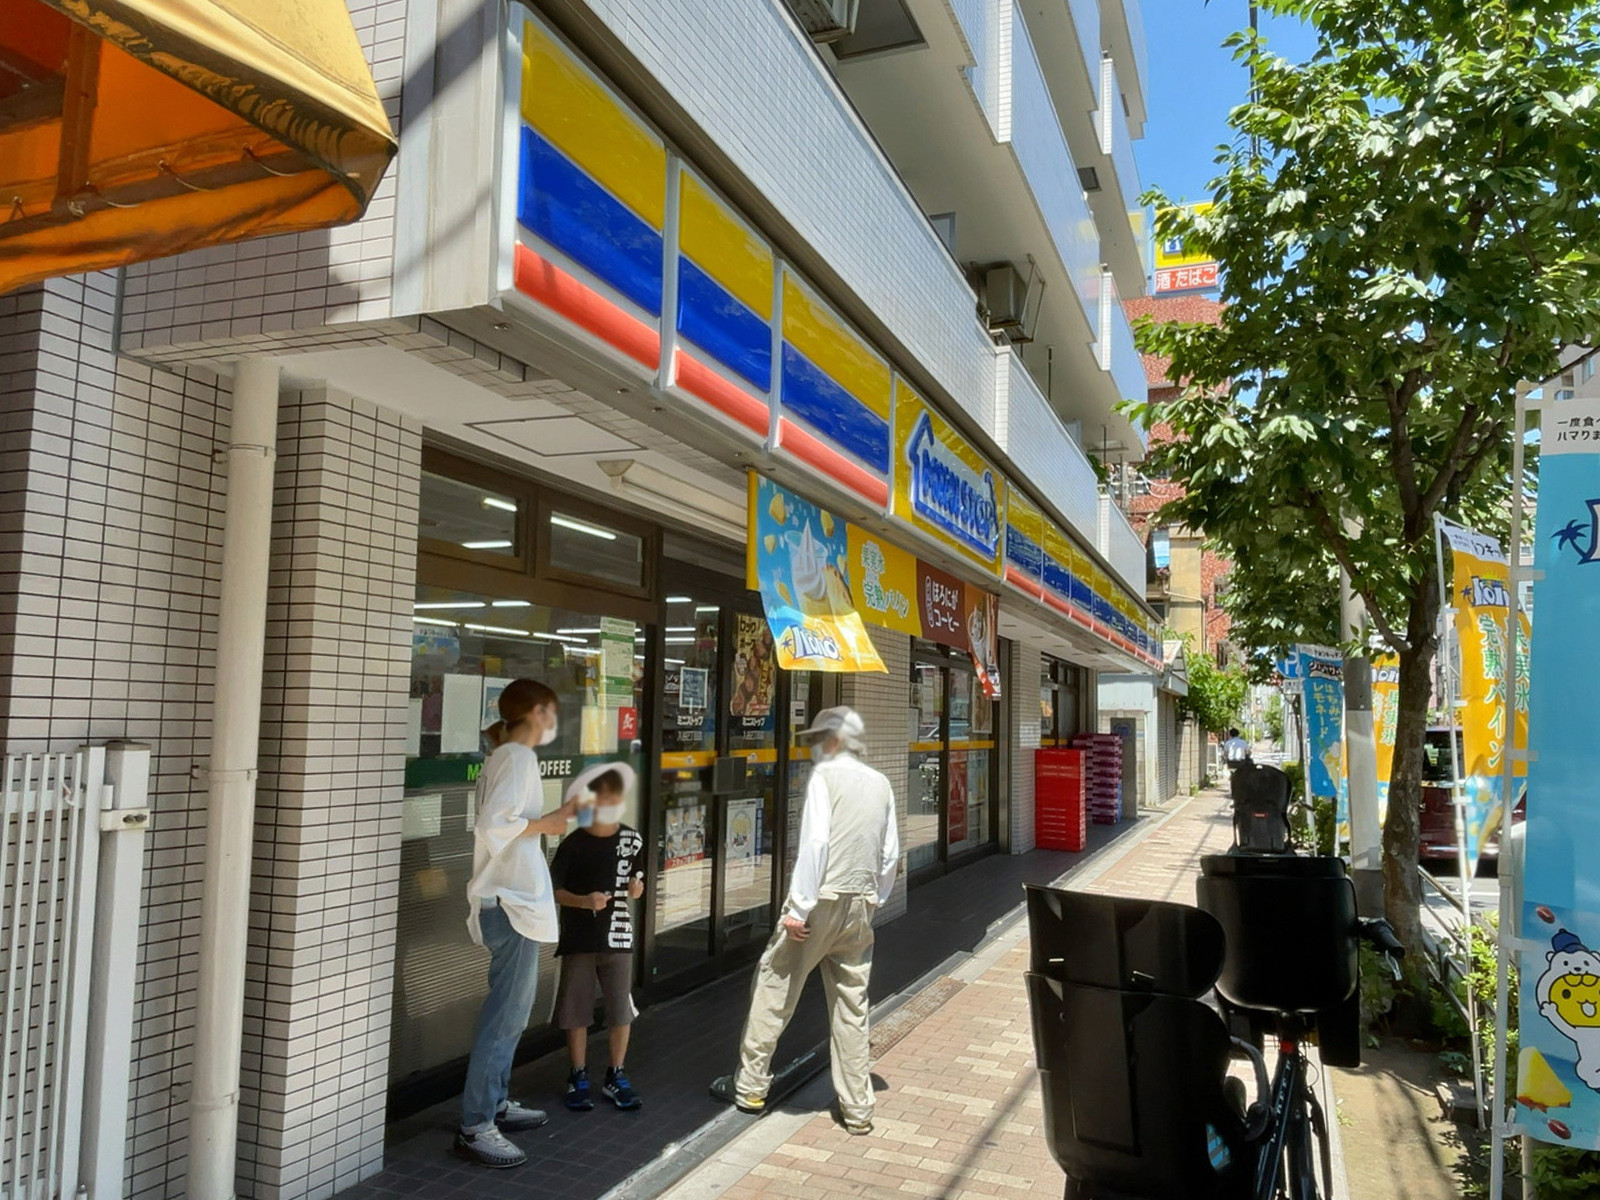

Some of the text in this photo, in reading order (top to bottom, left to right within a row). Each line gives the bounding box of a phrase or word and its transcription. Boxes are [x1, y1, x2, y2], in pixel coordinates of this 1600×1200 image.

[1157, 267, 1216, 290] 酒・たばこ
[933, 581, 958, 610] ほろにが
[933, 609, 960, 632] コーヒー
[538, 759, 572, 776] OFFEE
